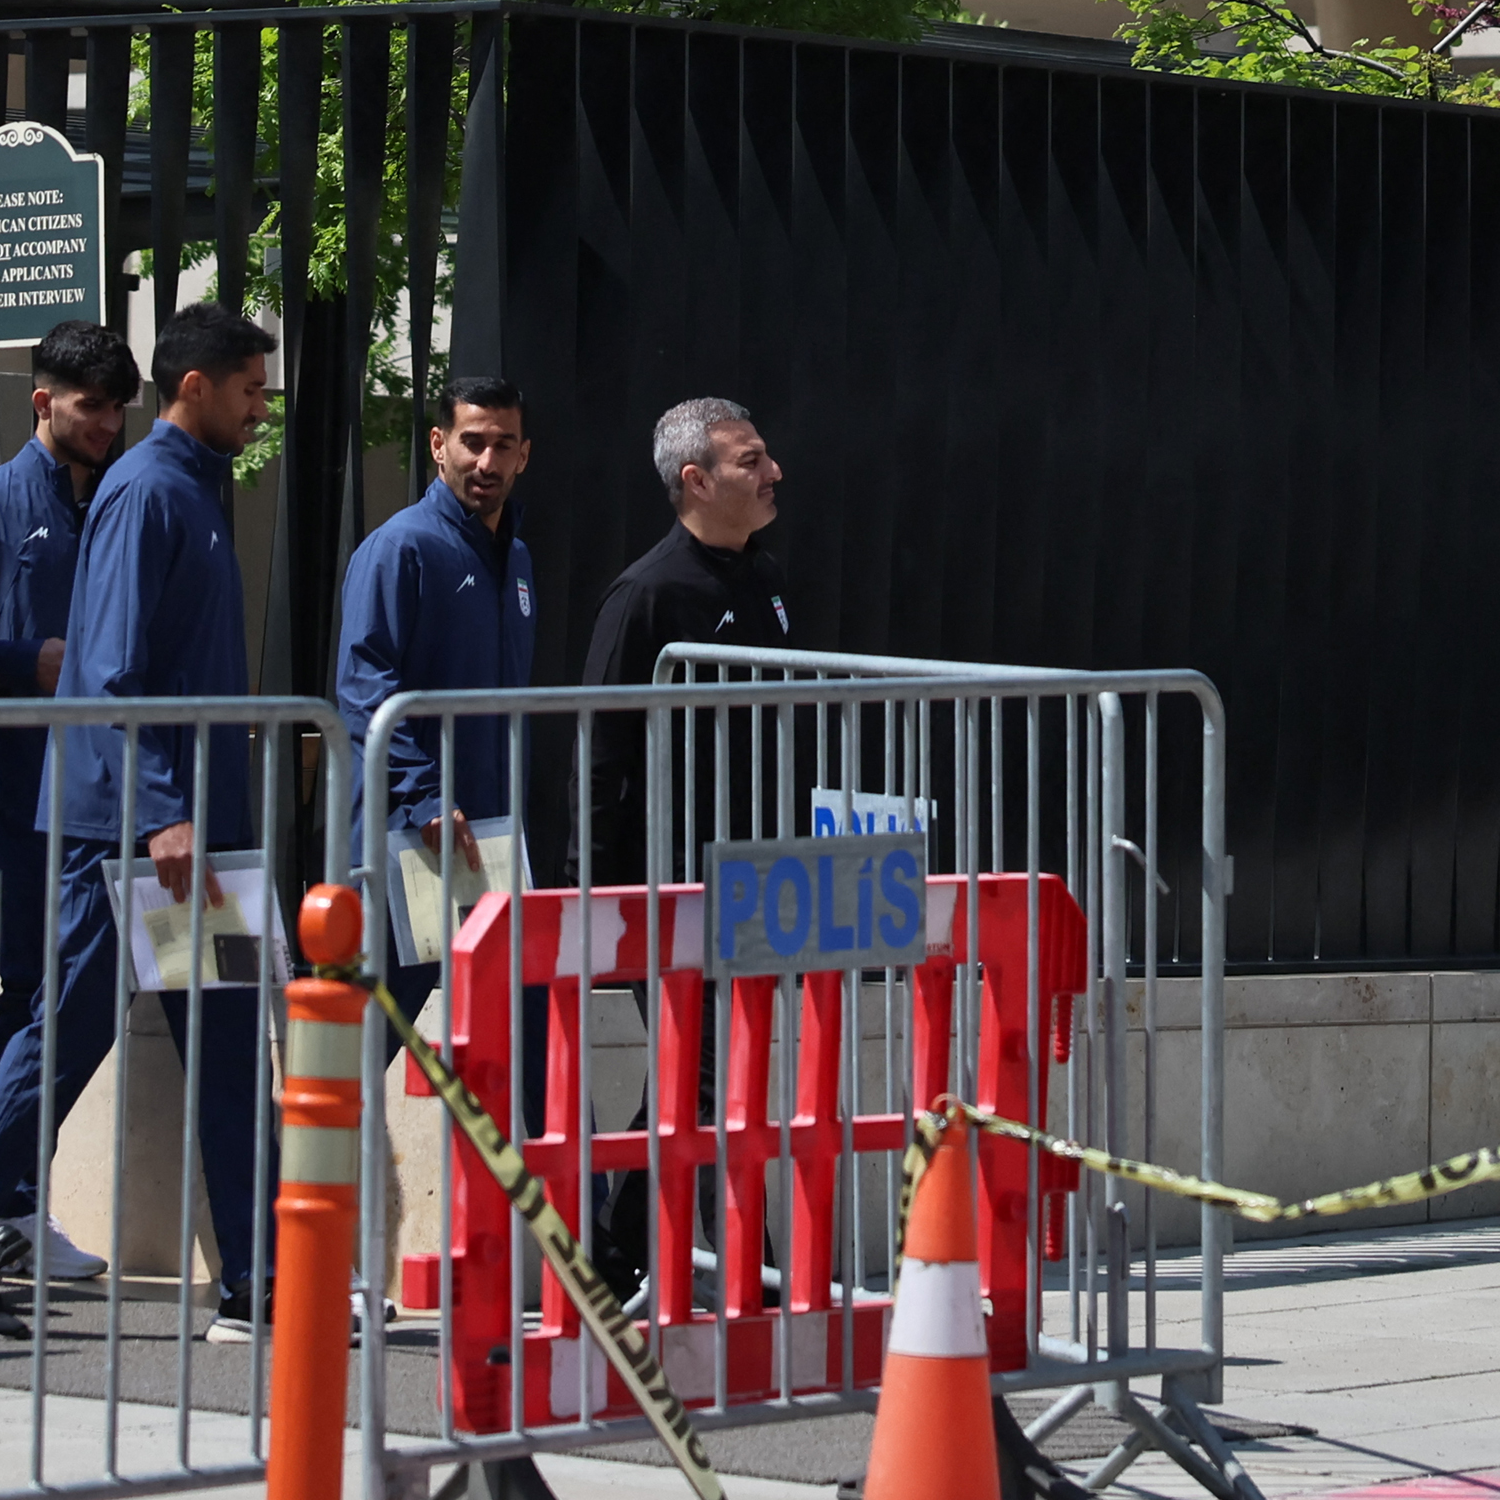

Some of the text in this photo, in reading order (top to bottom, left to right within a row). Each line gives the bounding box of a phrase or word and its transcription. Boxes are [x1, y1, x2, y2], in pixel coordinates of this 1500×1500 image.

[28, 190, 64, 206] NOTE:
[28, 214, 82, 231] CITIZENS
[12, 238, 87, 257] ACCOMPANY
[2, 264, 73, 282] APPLICANTS
[19, 288, 85, 306] INTERVIEW
